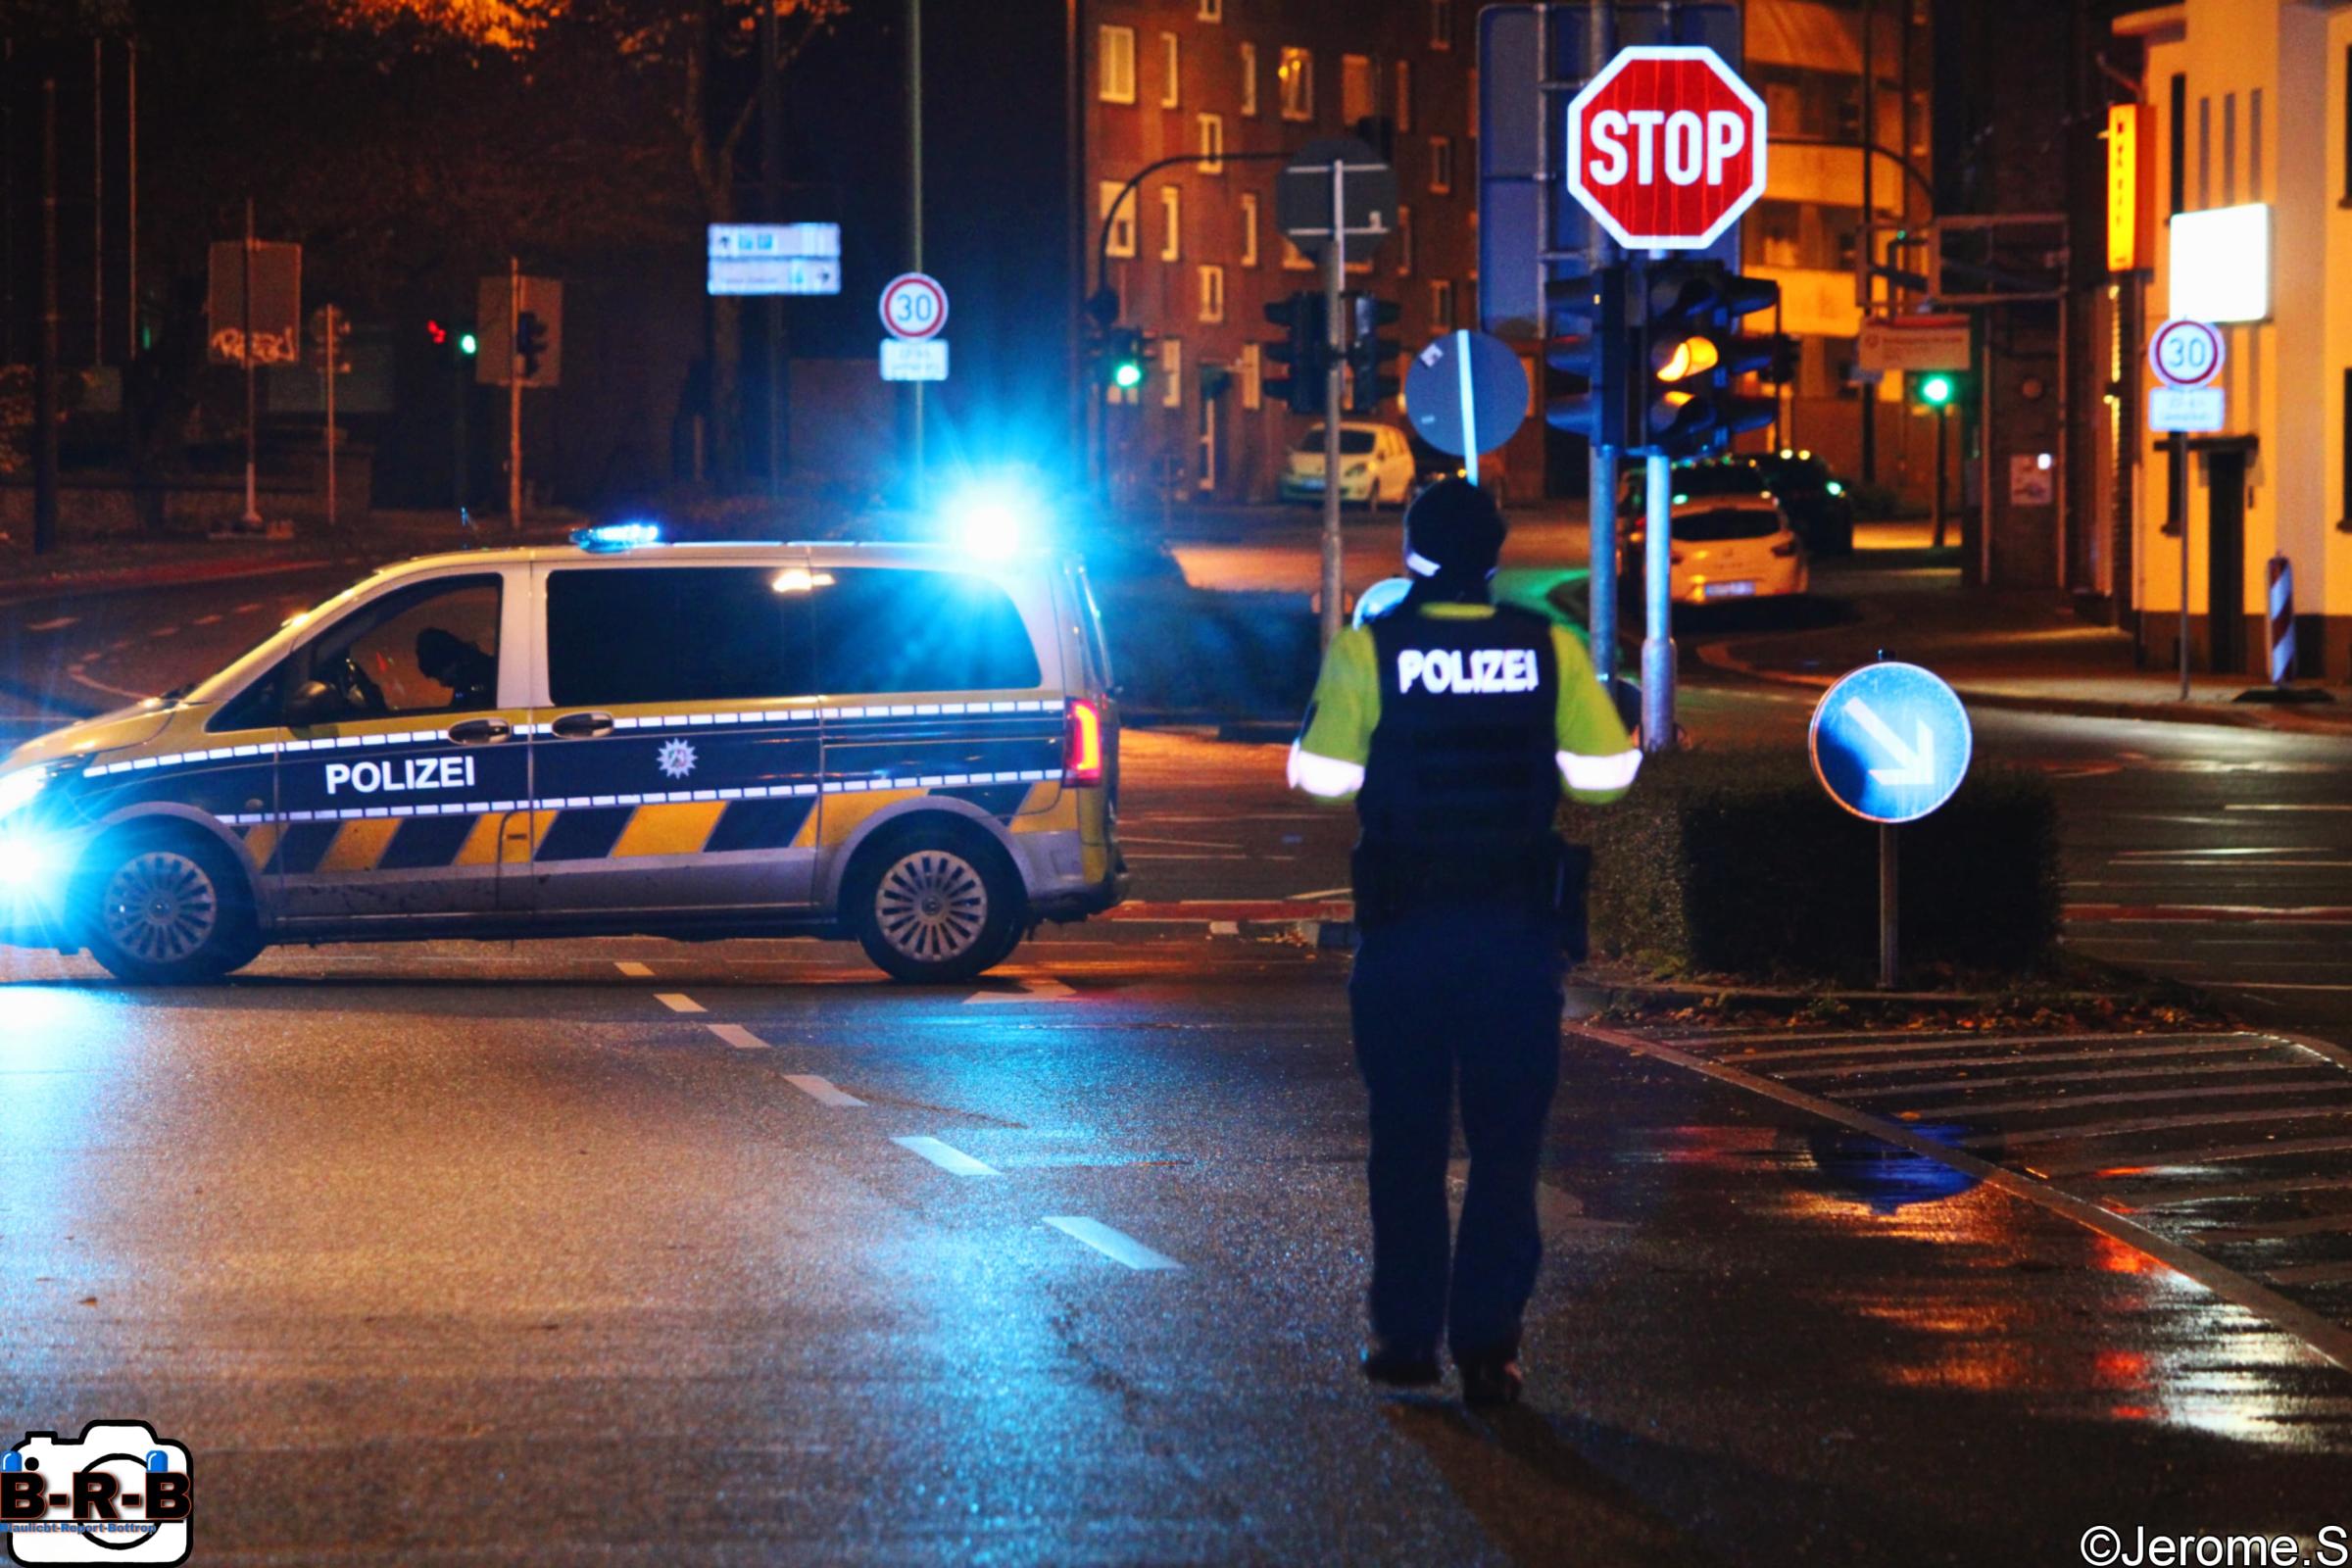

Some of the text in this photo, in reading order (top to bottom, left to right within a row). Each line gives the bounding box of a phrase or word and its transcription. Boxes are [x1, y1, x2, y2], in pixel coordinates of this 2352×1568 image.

[1589, 110, 1745, 185] STOP
[897, 294, 932, 321] 30
[2169, 337, 2206, 368] 30
[1397, 649, 1539, 694] POLIZEI
[325, 756, 475, 795] POLIZEI
